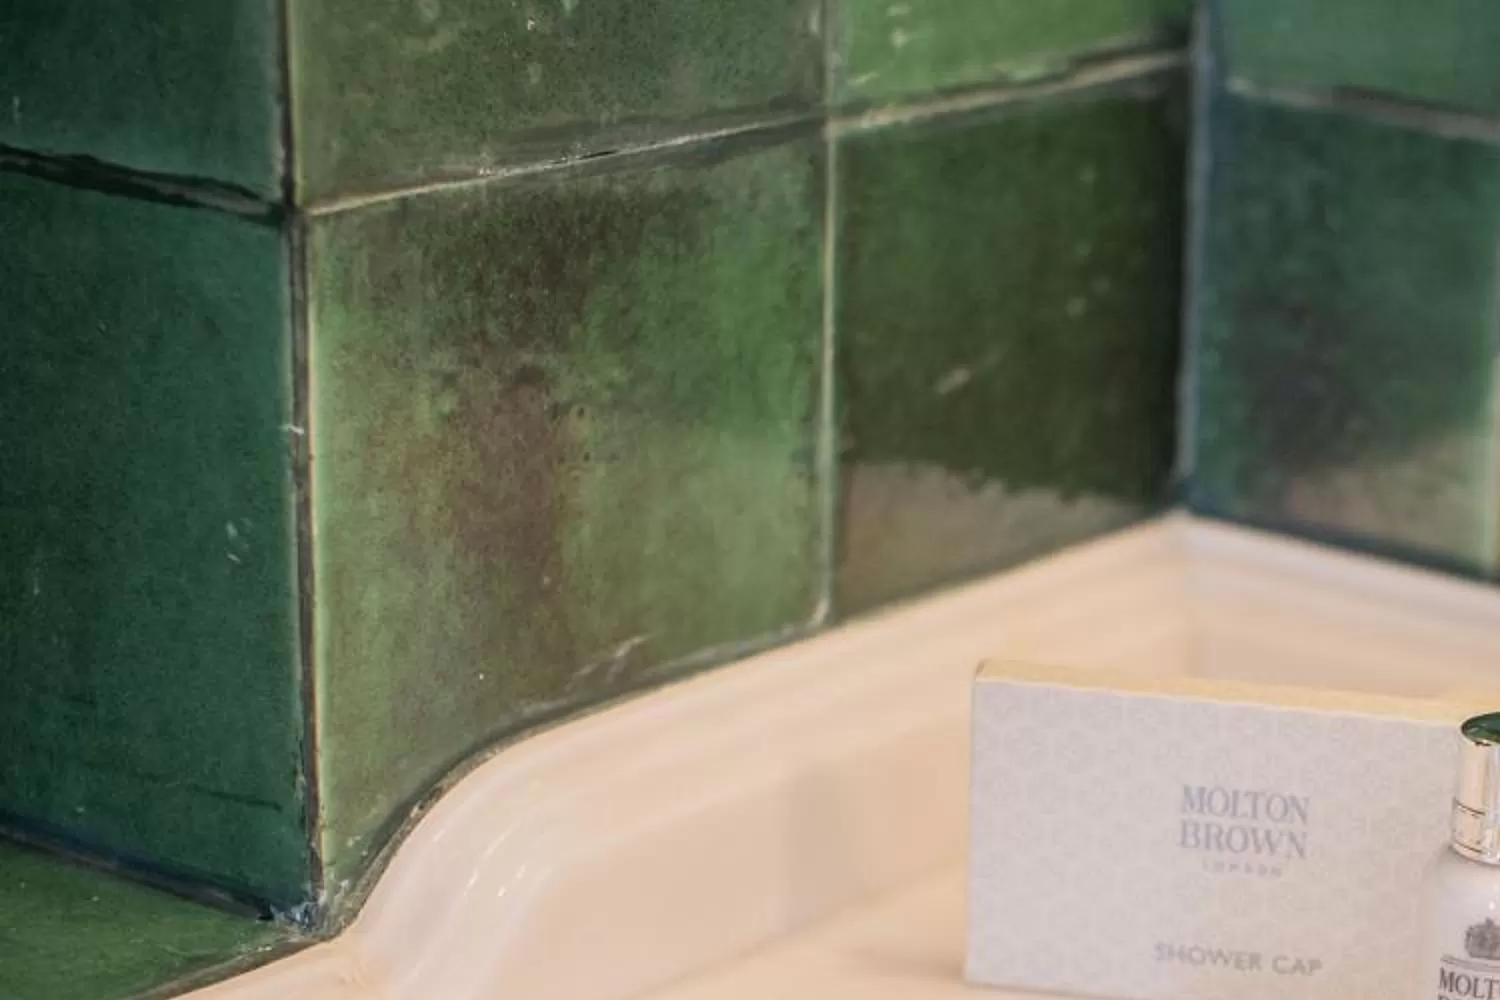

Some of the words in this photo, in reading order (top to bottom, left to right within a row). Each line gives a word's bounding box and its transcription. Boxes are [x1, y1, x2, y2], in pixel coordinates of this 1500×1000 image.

[1180, 784, 1311, 825] MOLTON
[1179, 818, 1307, 860] BROWN
[1153, 940, 1263, 973] SHOWER
[1271, 954, 1324, 976] CAP
